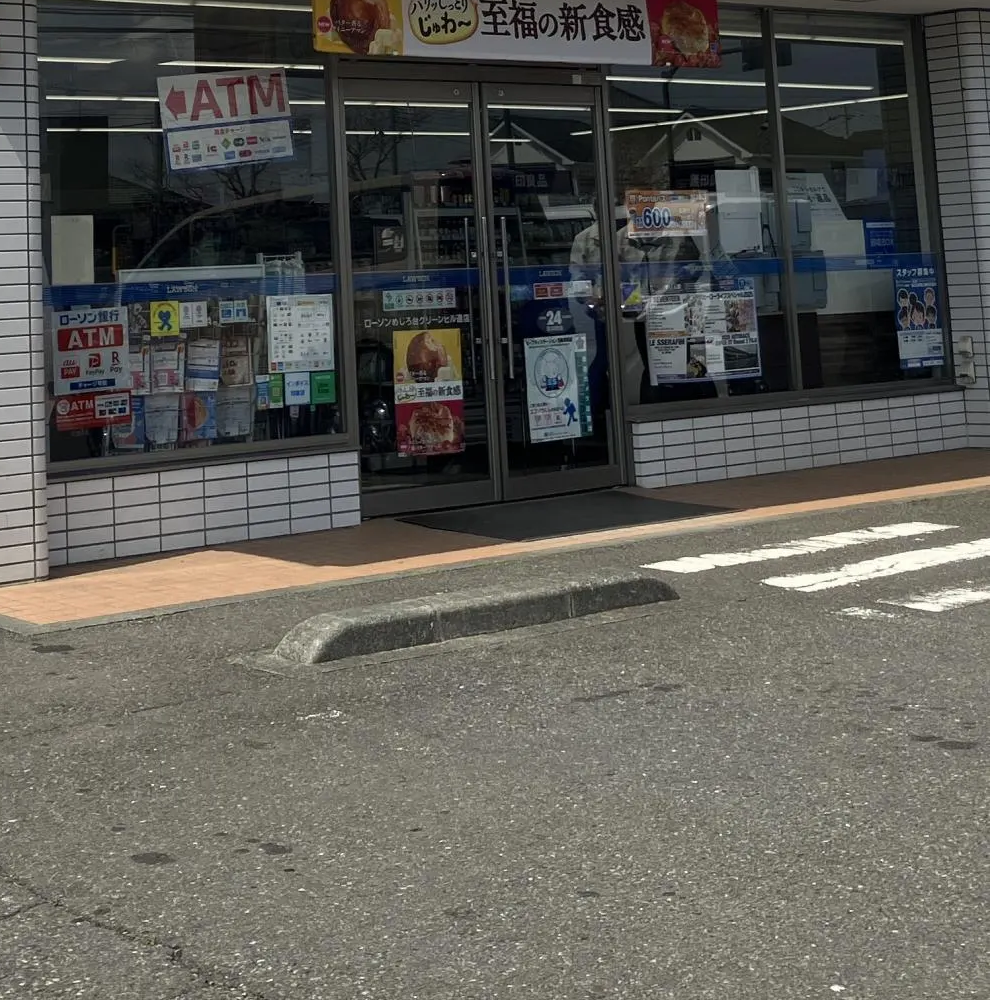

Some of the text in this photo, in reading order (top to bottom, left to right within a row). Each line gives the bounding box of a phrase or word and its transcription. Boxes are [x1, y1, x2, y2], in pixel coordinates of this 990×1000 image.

[190, 73, 286, 121] ATM
[643, 207, 671, 228] 600
[60, 310, 120, 326] ローソン銀行
[545, 310, 563, 326] 24
[68, 326, 115, 349] ATM
[111, 351, 121, 363] R
[70, 400, 94, 411] ATM
